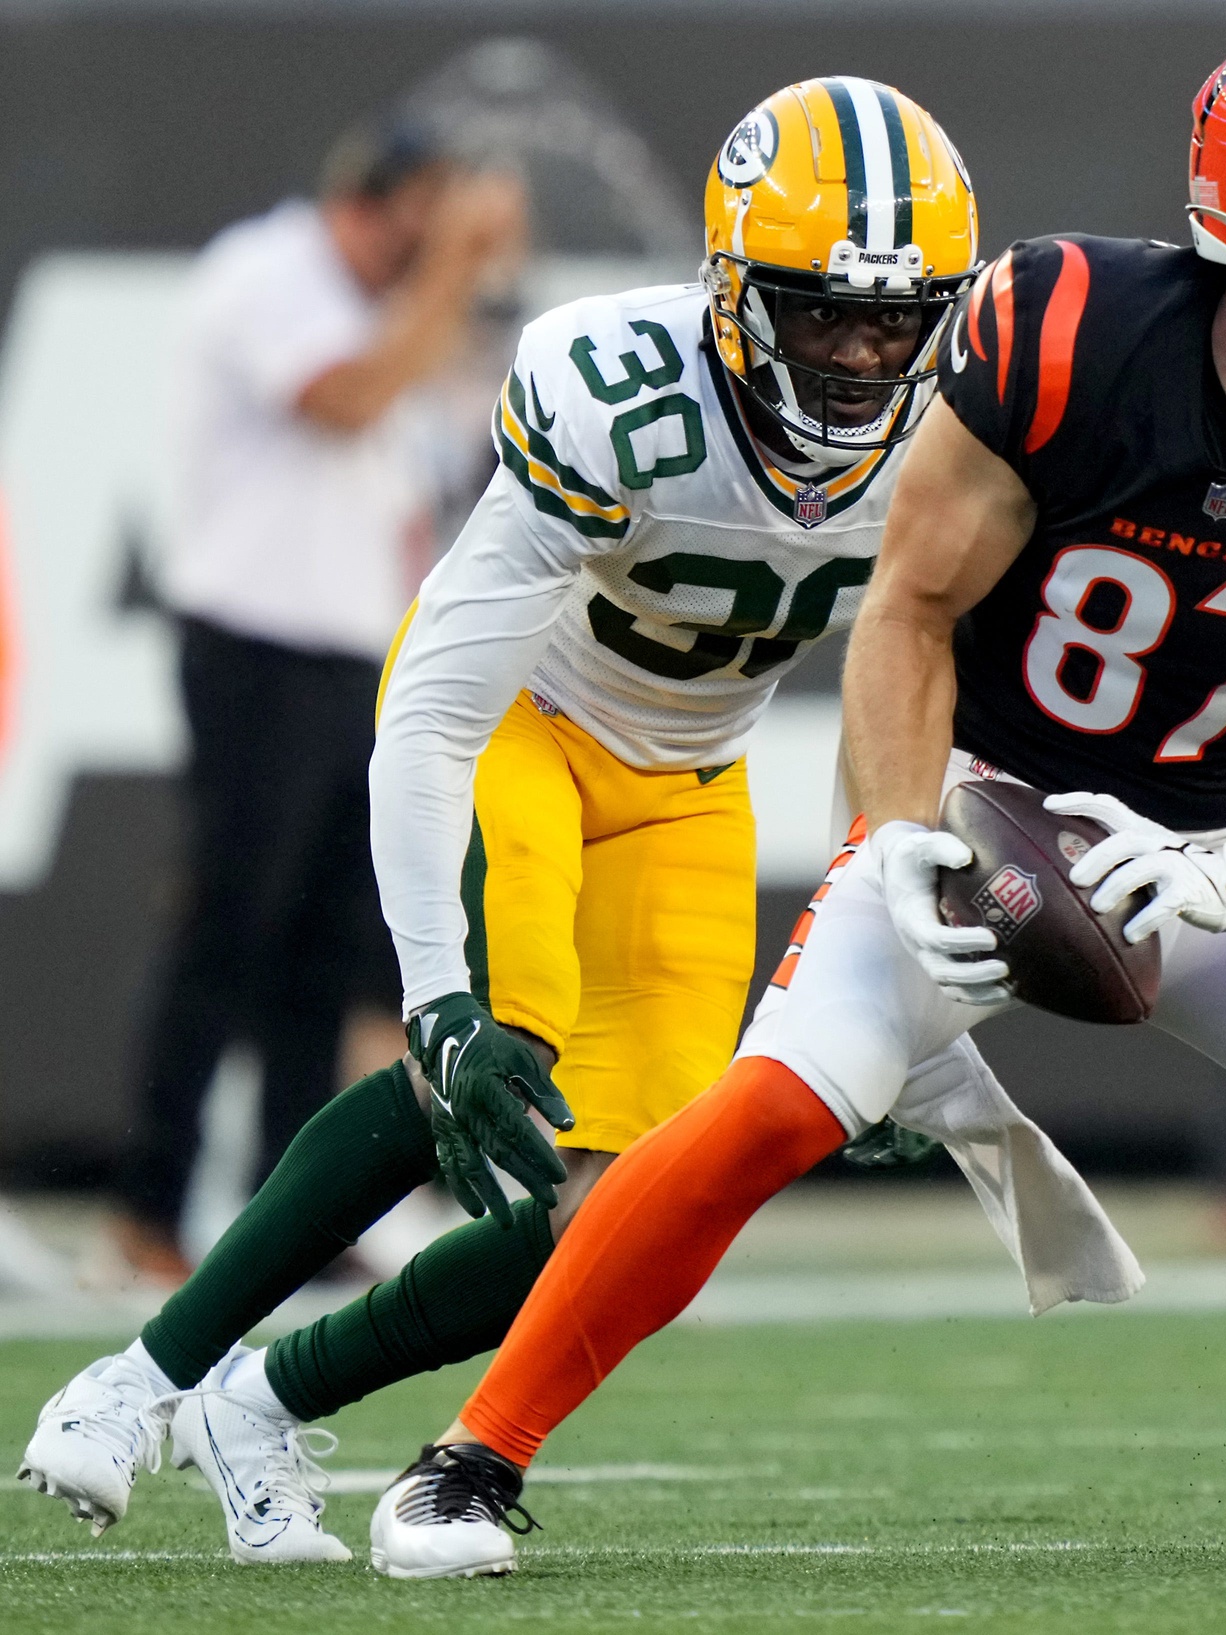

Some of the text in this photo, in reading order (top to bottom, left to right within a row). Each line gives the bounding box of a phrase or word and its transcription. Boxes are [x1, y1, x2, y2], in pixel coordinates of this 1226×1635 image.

[858, 252, 899, 265] PACKERS
[568, 319, 708, 490] 30
[799, 503, 823, 520] NFL
[972, 759, 996, 779] NFL
[994, 871, 1036, 921] NFL
